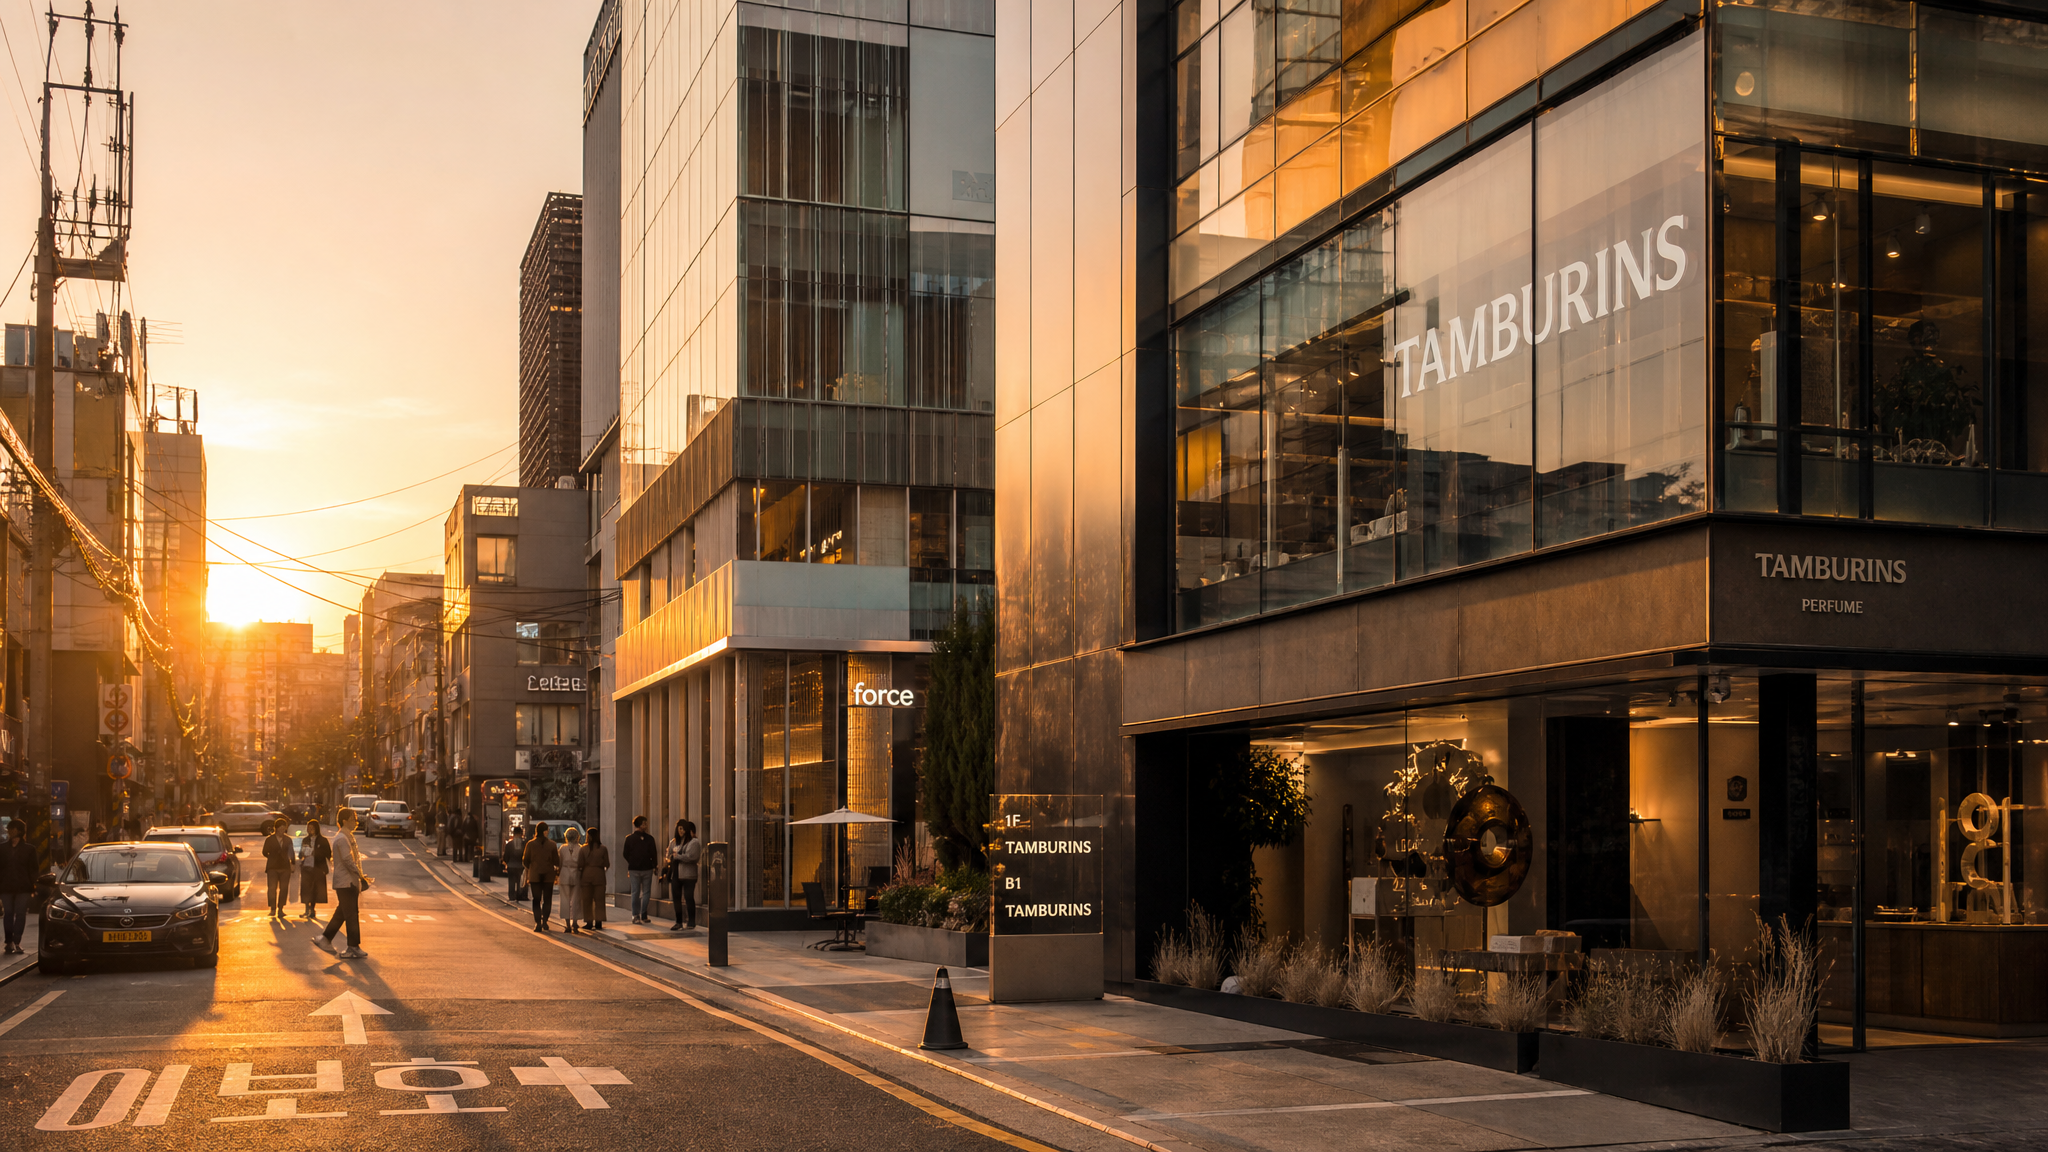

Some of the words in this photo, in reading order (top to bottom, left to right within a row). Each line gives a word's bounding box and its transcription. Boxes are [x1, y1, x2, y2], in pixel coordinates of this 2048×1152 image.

[1394, 214, 1686, 398] TAMBURINS
[1755, 552, 1907, 584] TAMBURINS
[1802, 598, 1864, 614] PERFUME
[852, 681, 914, 706] force
[1005, 814, 1021, 827] 1F
[1005, 840, 1092, 854] TAMBURINS
[1005, 877, 1021, 890] B1
[1005, 903, 1092, 917] TAMBURINS
